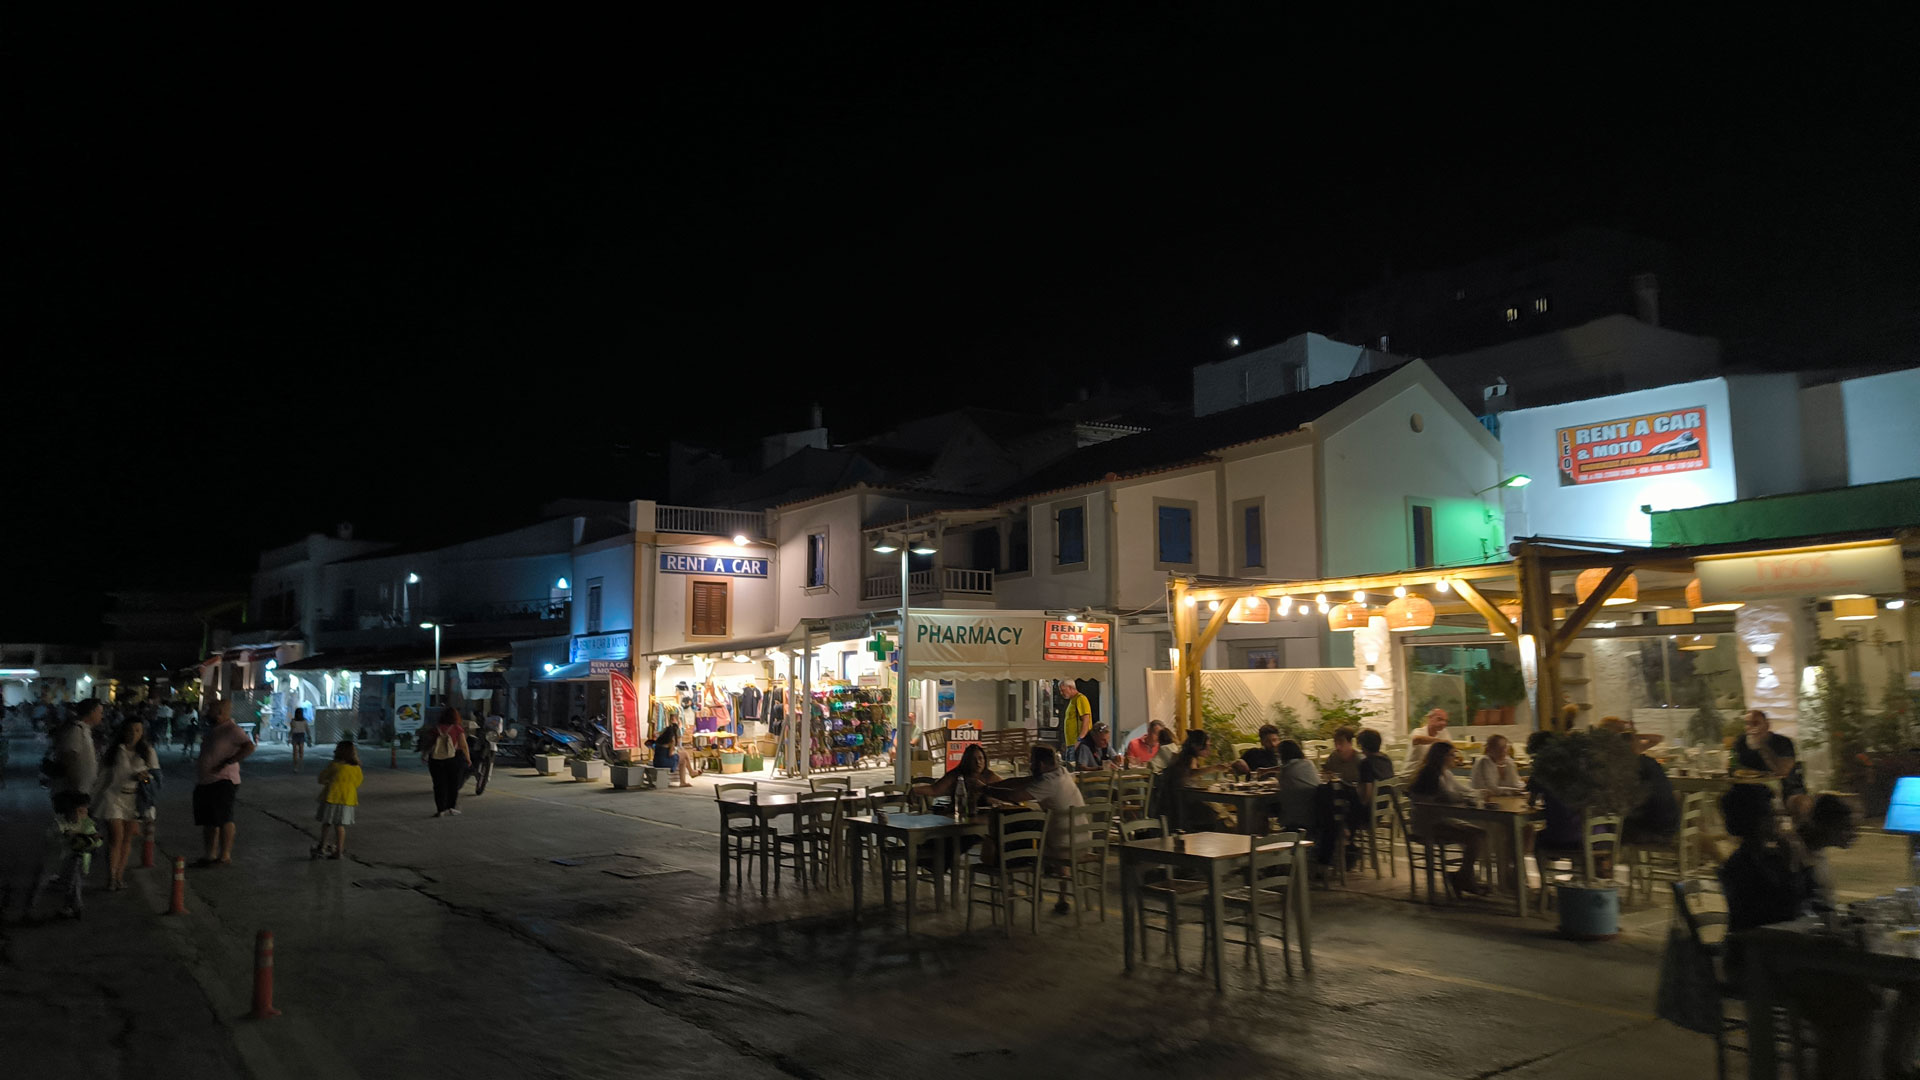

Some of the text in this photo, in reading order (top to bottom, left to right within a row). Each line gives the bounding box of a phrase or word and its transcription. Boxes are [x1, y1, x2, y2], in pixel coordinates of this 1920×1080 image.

[1576, 412, 1701, 445] RENT A CAR
[1577, 449, 1591, 460] &
[1592, 440, 1643, 458] MOTO
[667, 555, 761, 574] RENT A CAR
[917, 624, 1023, 645] PHARMACY
[1051, 624, 1084, 633] RENT
[1060, 634, 1084, 642] CAR
[951, 730, 979, 740] LEON
